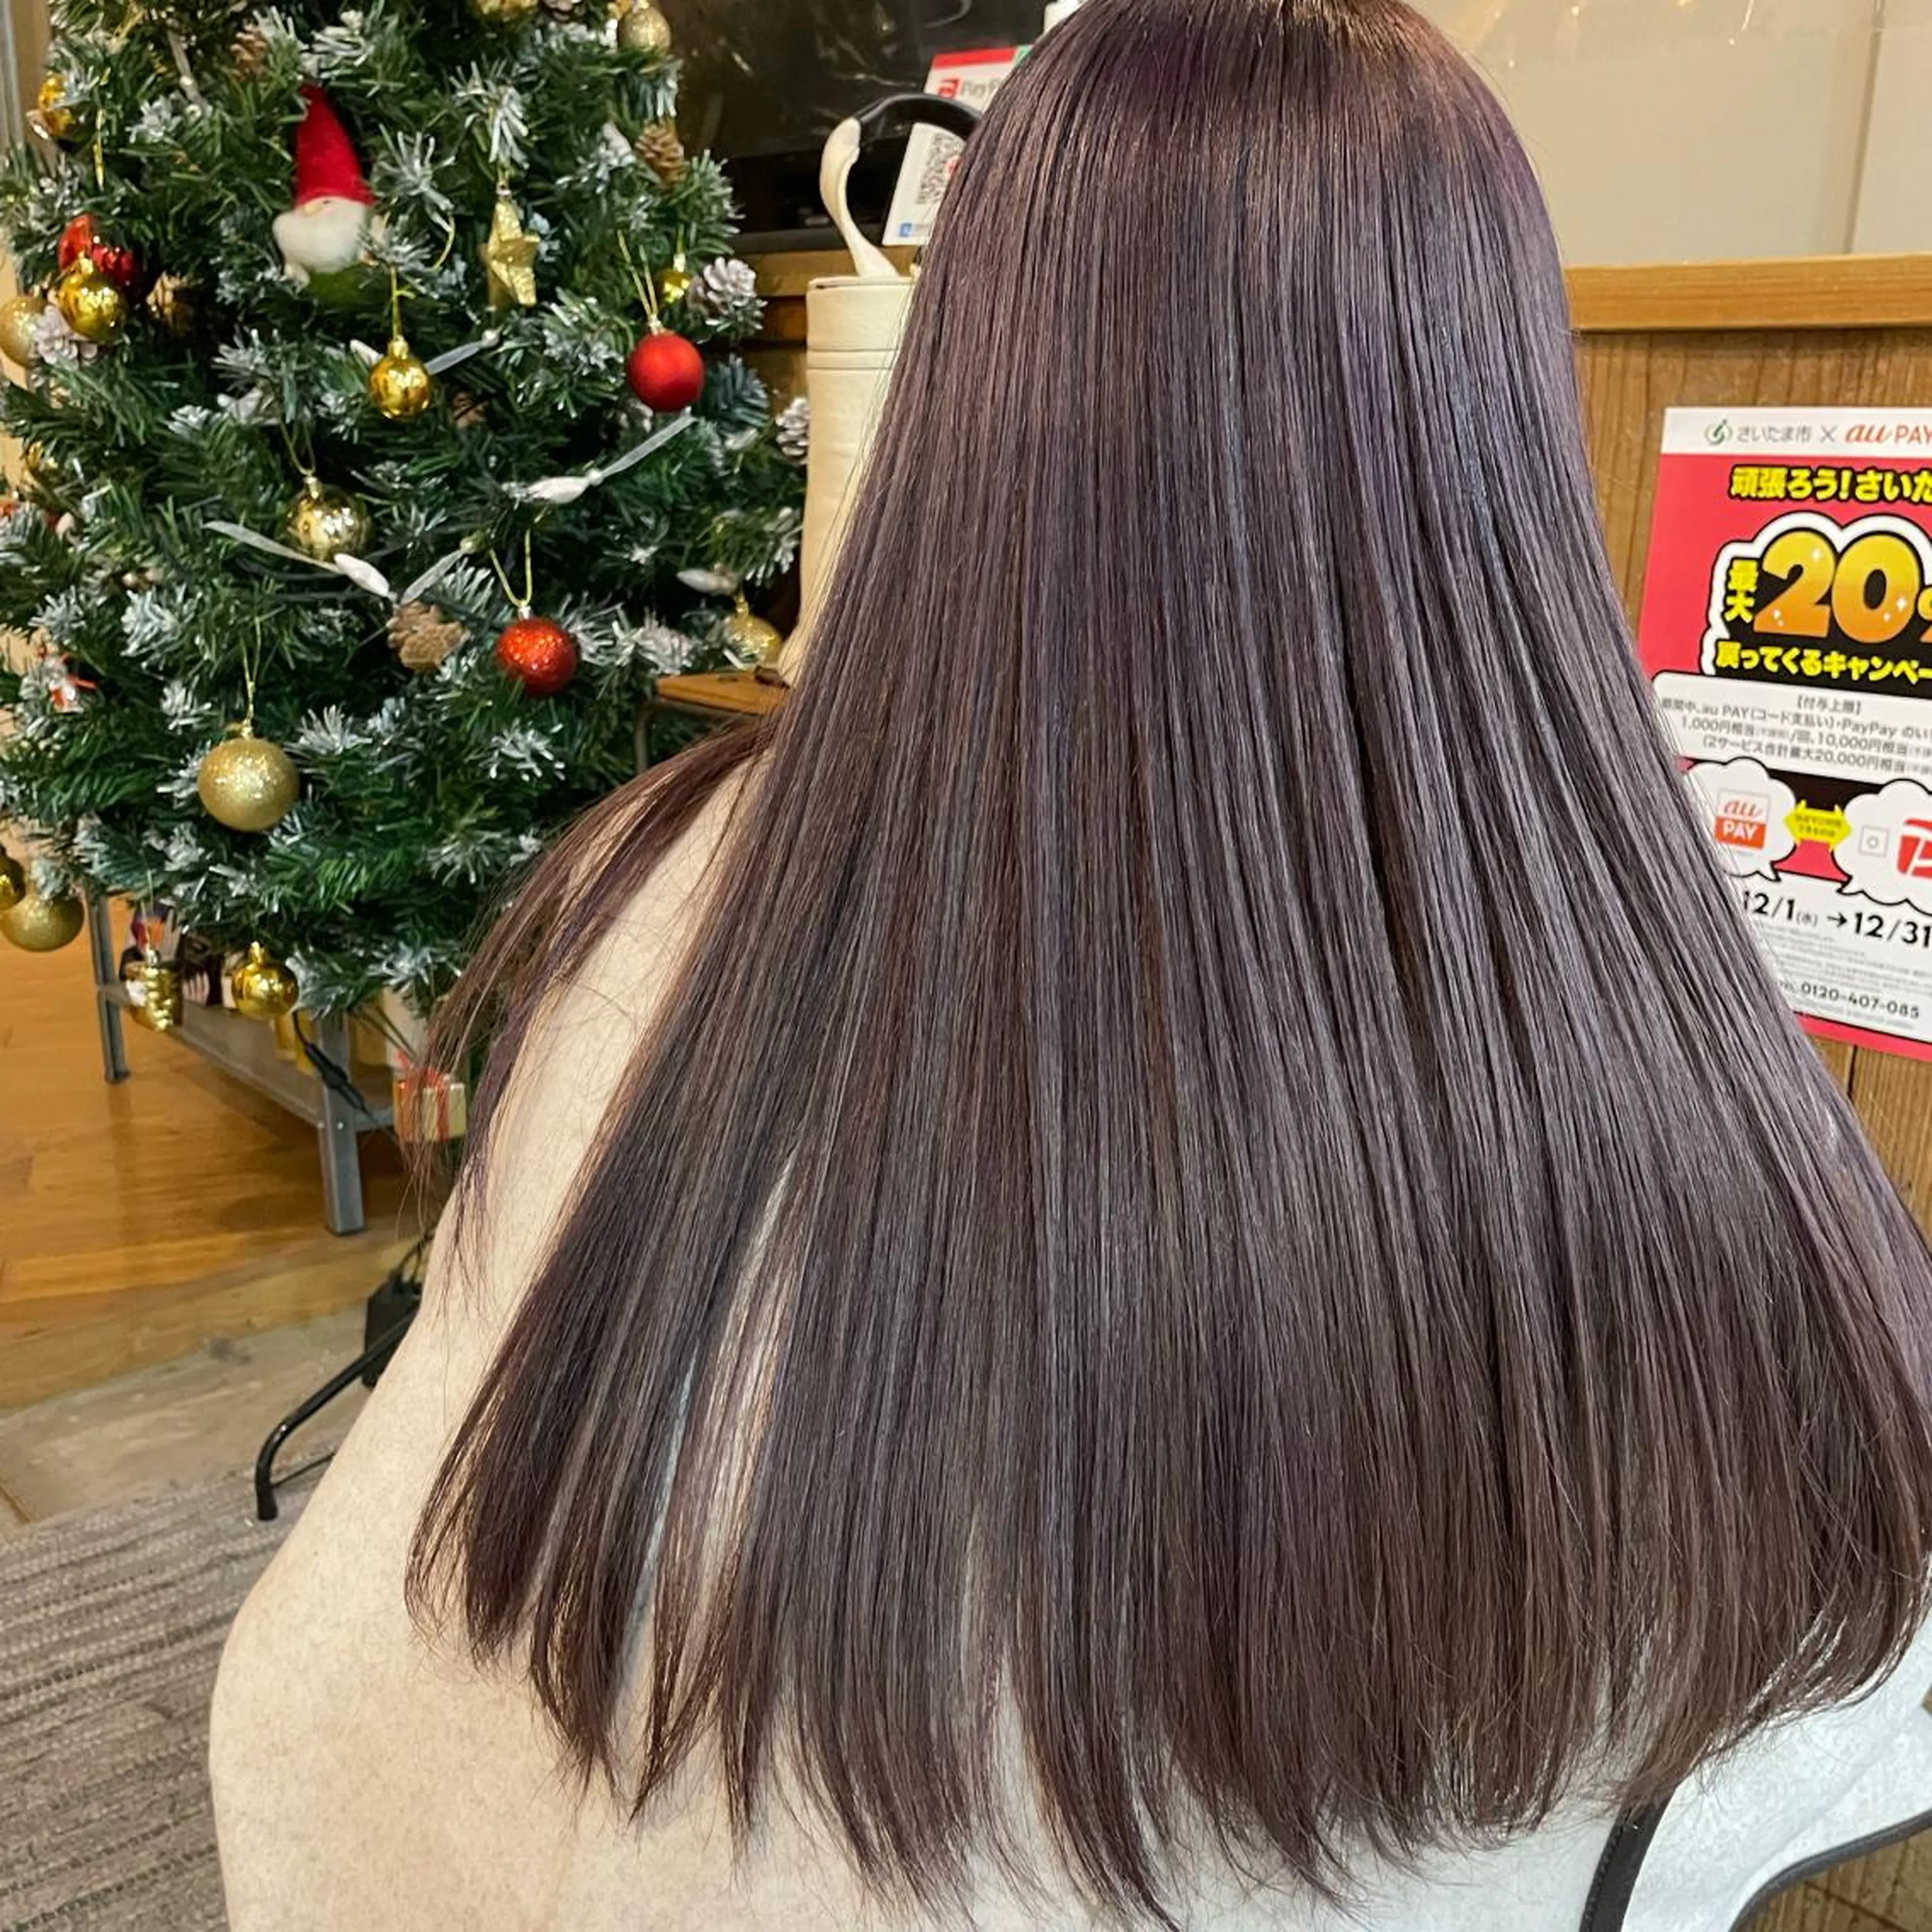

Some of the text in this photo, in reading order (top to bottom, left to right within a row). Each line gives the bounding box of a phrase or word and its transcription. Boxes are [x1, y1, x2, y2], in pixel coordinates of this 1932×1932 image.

[1737, 425, 1811, 443] さいたま市
[1845, 424, 1893, 443] au
[1724, 559, 1758, 623] 最大
[1723, 799, 1764, 818] au
[1723, 822, 1758, 841] PAY
[1855, 912, 1931, 948] 12/31
[1801, 981, 1920, 1019] 0120-407-085
